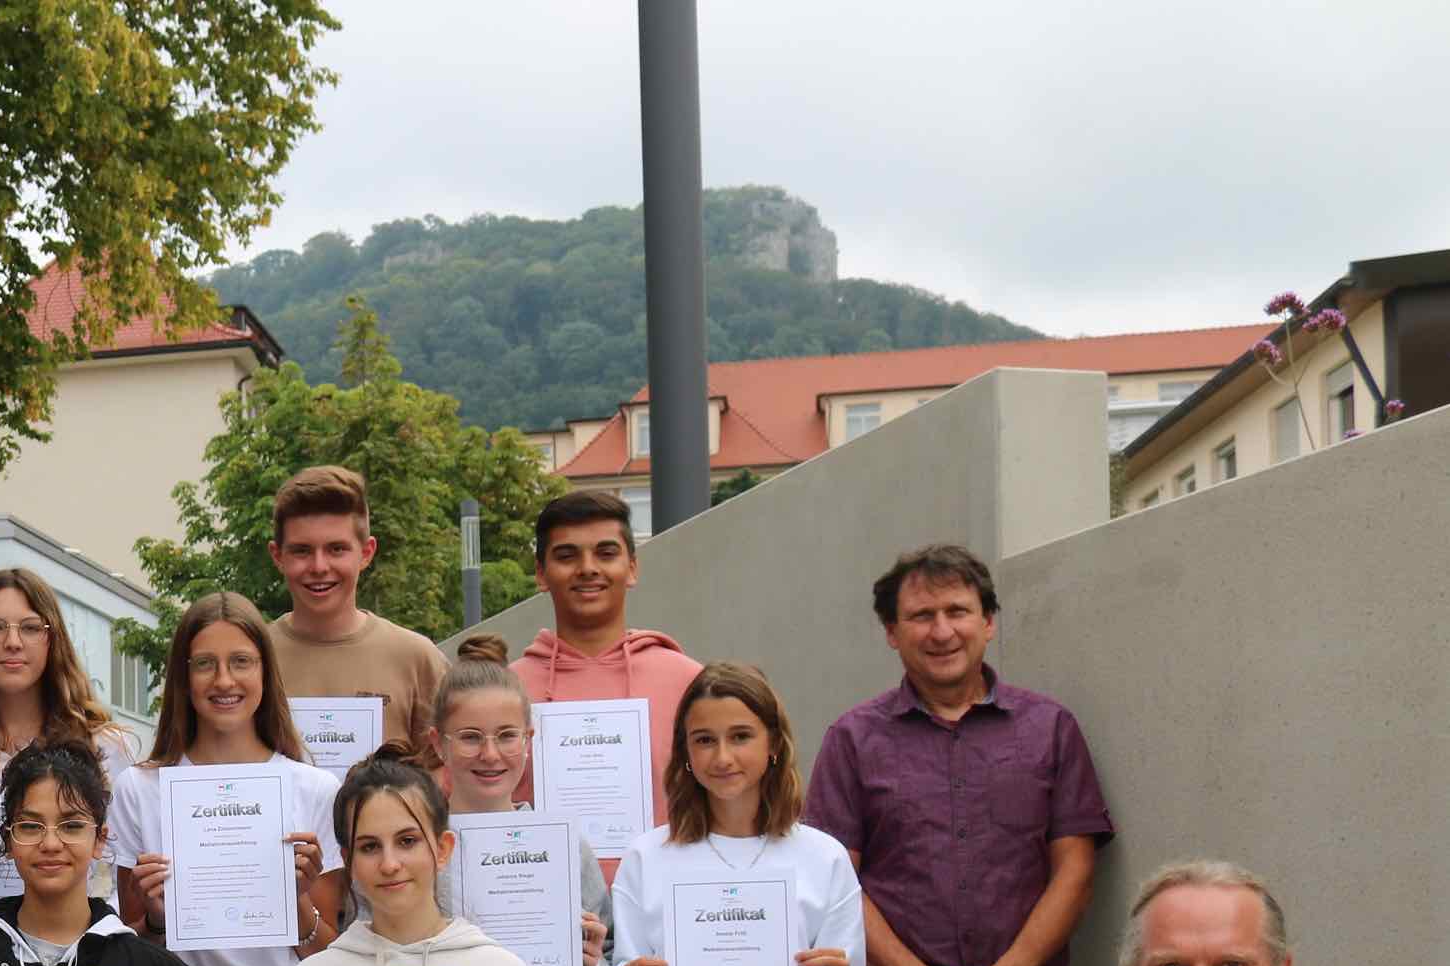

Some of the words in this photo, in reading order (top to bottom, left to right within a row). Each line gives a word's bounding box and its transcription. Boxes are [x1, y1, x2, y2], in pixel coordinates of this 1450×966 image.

[305, 731, 356, 743] ertifikat
[559, 733, 623, 747] Zertifikat
[190, 803, 263, 818] Zertifikat
[480, 850, 550, 866] Zertifikat
[694, 908, 767, 922] Zertifikat
